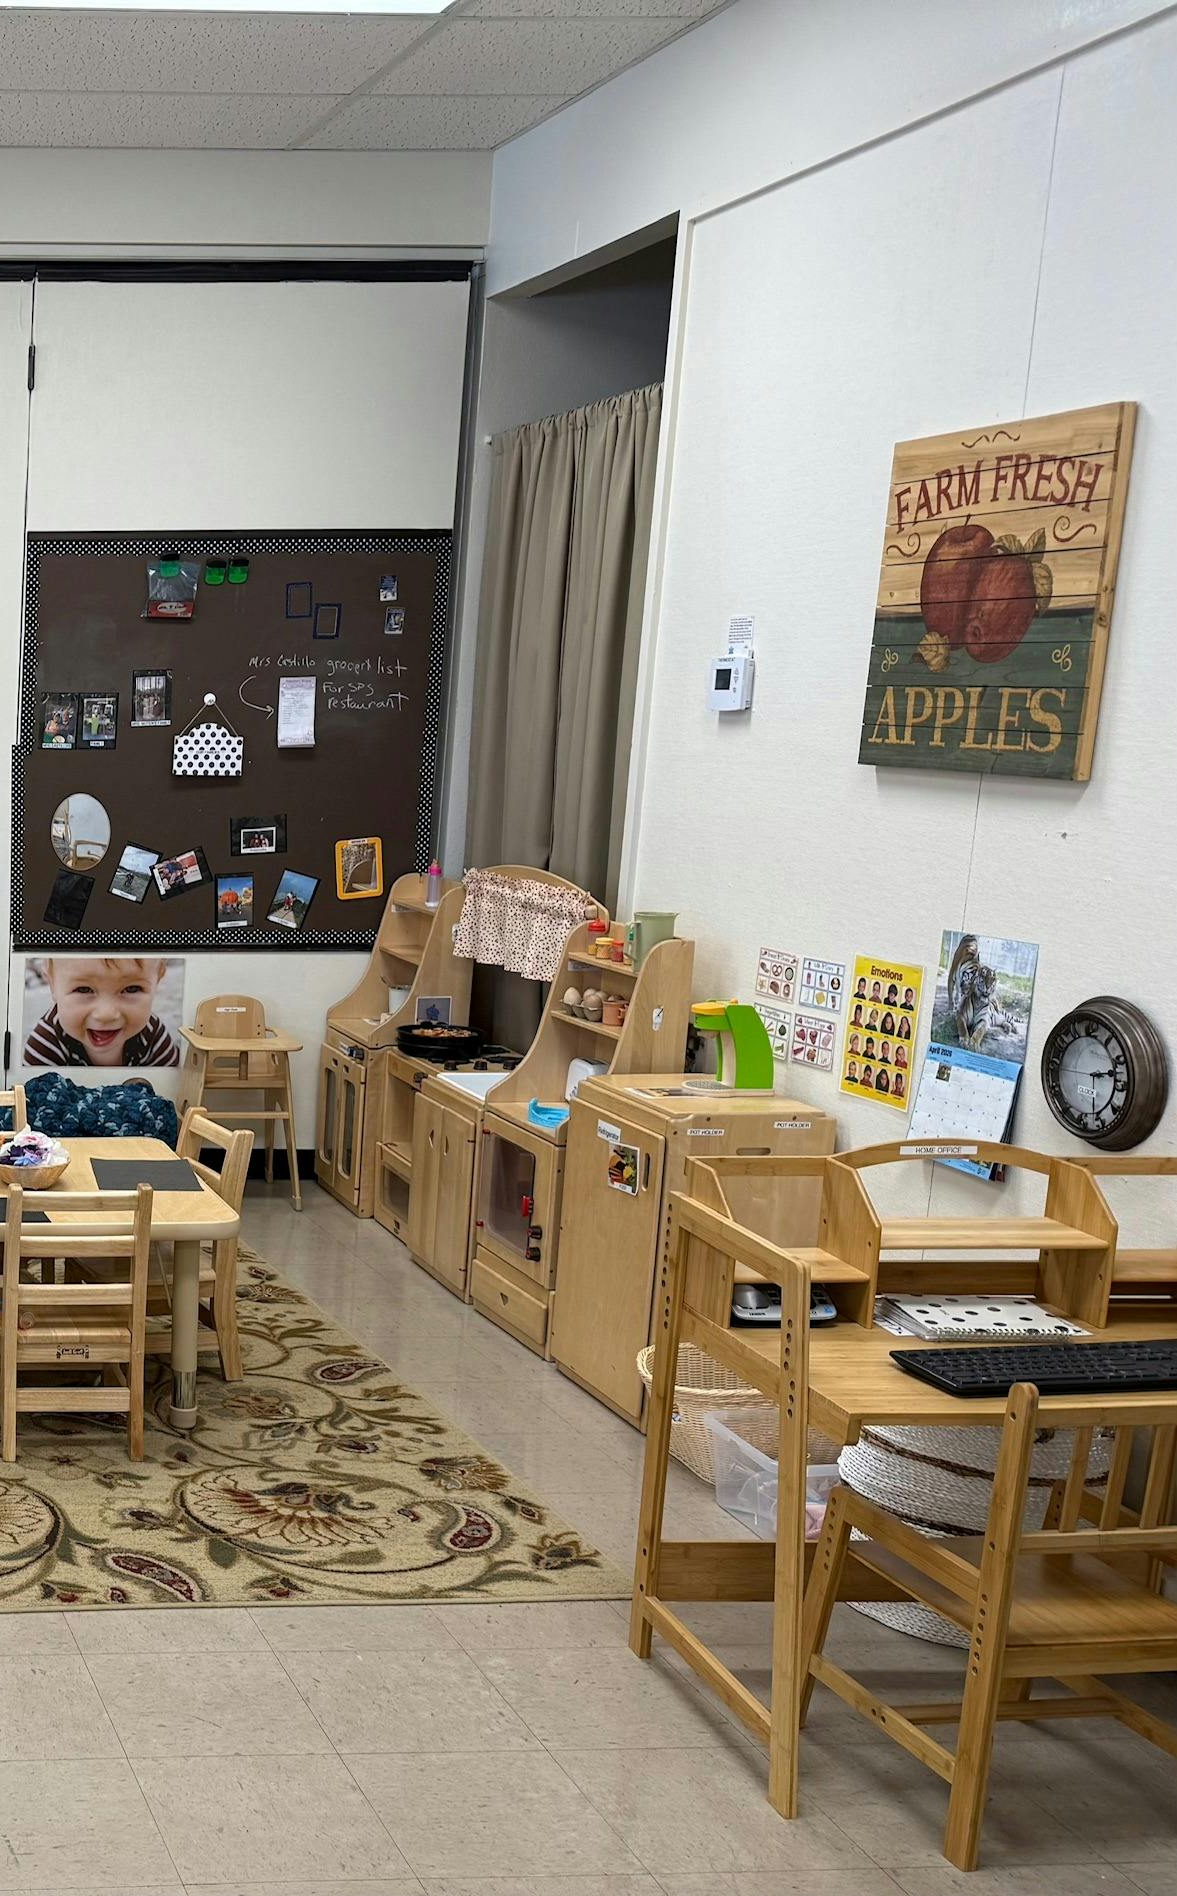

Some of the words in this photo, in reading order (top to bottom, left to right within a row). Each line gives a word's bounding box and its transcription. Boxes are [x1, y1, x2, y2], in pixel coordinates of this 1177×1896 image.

[895, 460, 984, 533] FARM
[990, 453, 1104, 512] FRESH
[377, 656, 408, 677] list
[868, 687, 1067, 753] APPLES
[870, 966, 903, 982] Emotions
[928, 1046, 940, 1055] April
[1078, 1086, 1095, 1095] CLOCK
